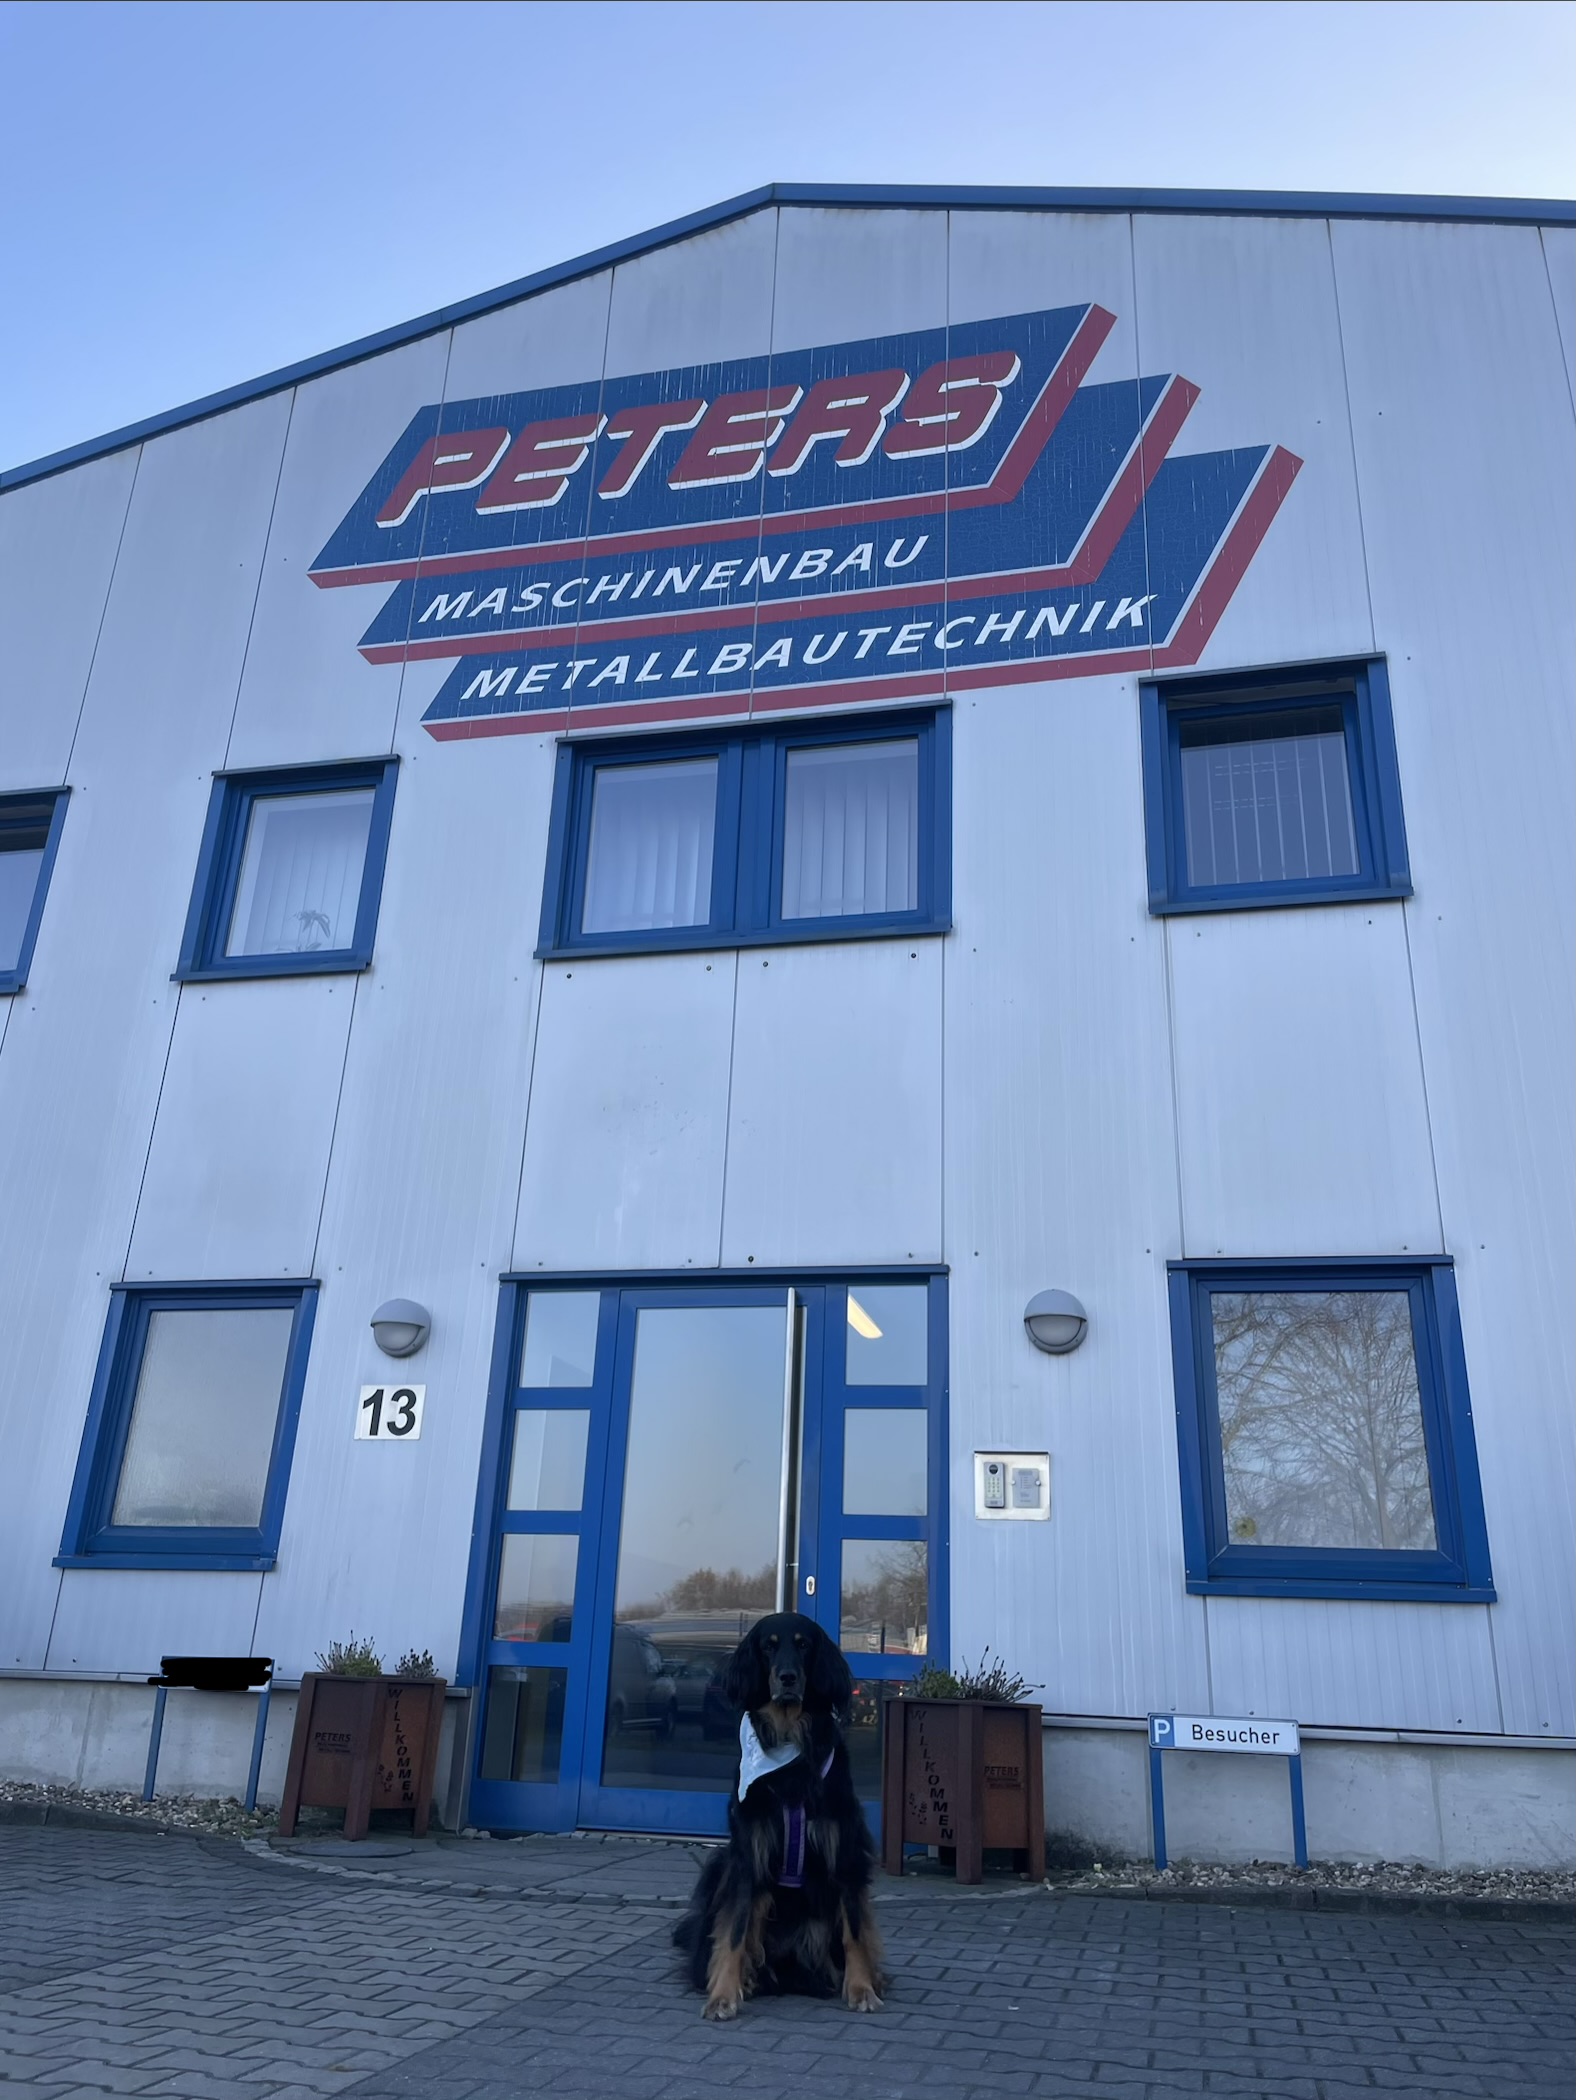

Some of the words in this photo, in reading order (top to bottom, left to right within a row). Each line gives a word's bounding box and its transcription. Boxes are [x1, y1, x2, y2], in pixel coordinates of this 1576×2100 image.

[375, 351, 1020, 528] PETERS
[418, 535, 928, 624] MASCHINENBAU
[461, 594, 1158, 700] METALLBAUTECHNIK
[363, 1388, 417, 1436] 13
[314, 1731, 352, 1743] PETERS
[387, 1688, 414, 1801] WILLKOMMEN
[910, 1709, 954, 1840] WILLKOMMEN
[984, 1766, 1019, 1777] PETERS
[1153, 1718, 1170, 1743] P
[1191, 1724, 1280, 1745] Besucher
